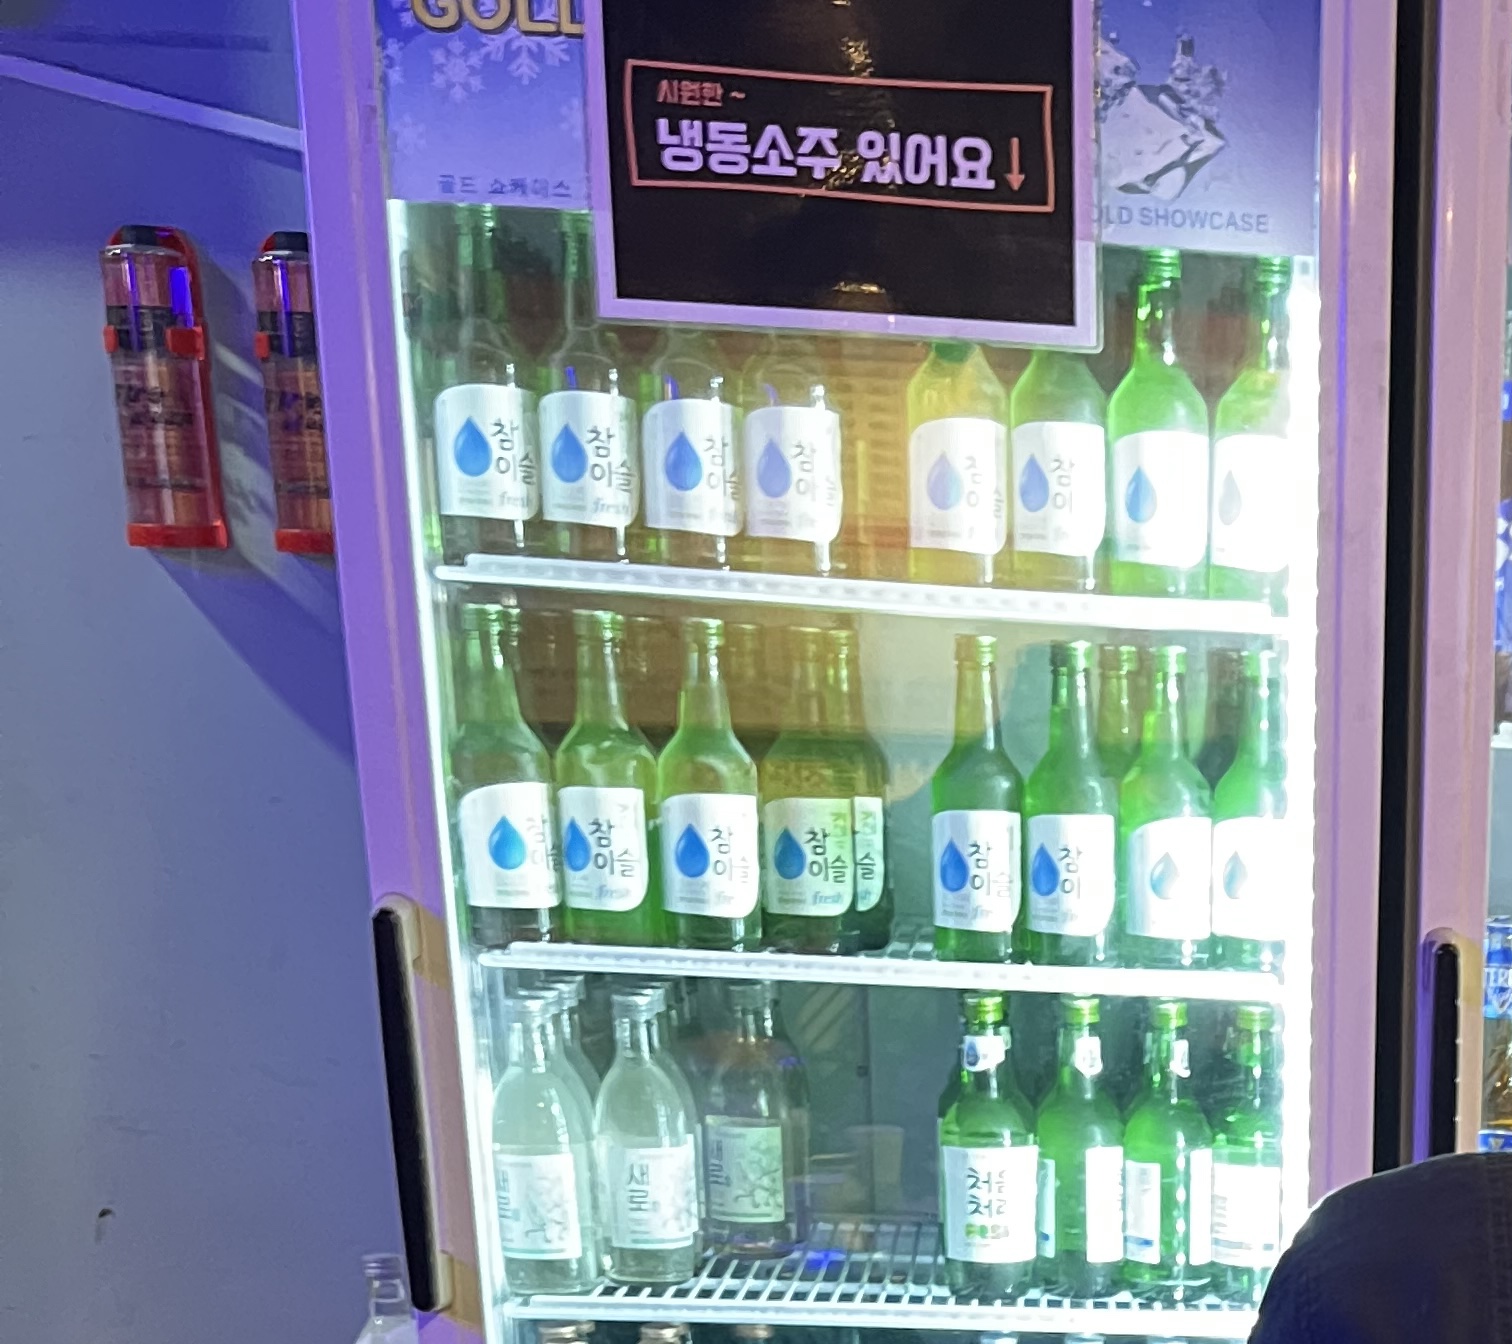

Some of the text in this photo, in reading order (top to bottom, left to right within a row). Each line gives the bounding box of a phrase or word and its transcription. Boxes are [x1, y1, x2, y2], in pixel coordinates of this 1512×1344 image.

[657, 118, 996, 191] 냉동소주 있어요
[438, 174, 573, 199] 골드 쇼케이스
[1138, 206, 1269, 233] SHOWCASE
[490, 418, 537, 486] 참이슬
[586, 424, 637, 492] 참이슬
[588, 819, 641, 879] 참이슬
[804, 829, 848, 885] 참이슬
[1058, 843, 1084, 898] 참이
[627, 1163, 650, 1213] 새로
